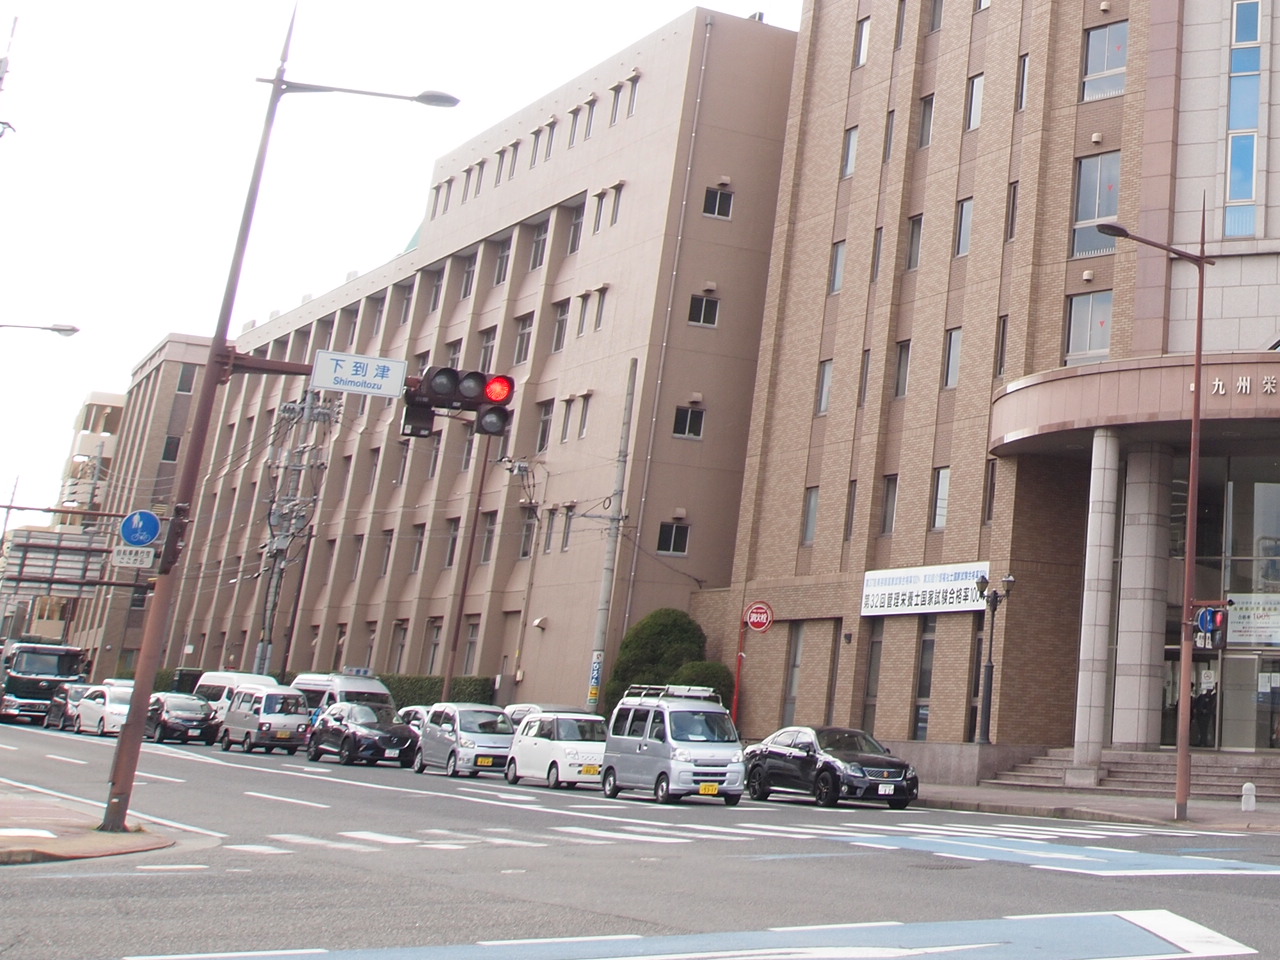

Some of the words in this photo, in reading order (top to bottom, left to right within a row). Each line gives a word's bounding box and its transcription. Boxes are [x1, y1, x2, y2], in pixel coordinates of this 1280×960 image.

[330, 358, 391, 380] 下到津
[333, 376, 383, 390] Shimoitozu
[864, 587, 981, 609] 第32回管理栄養士国家試験合格率100
[750, 613, 768, 623] 消火栓
